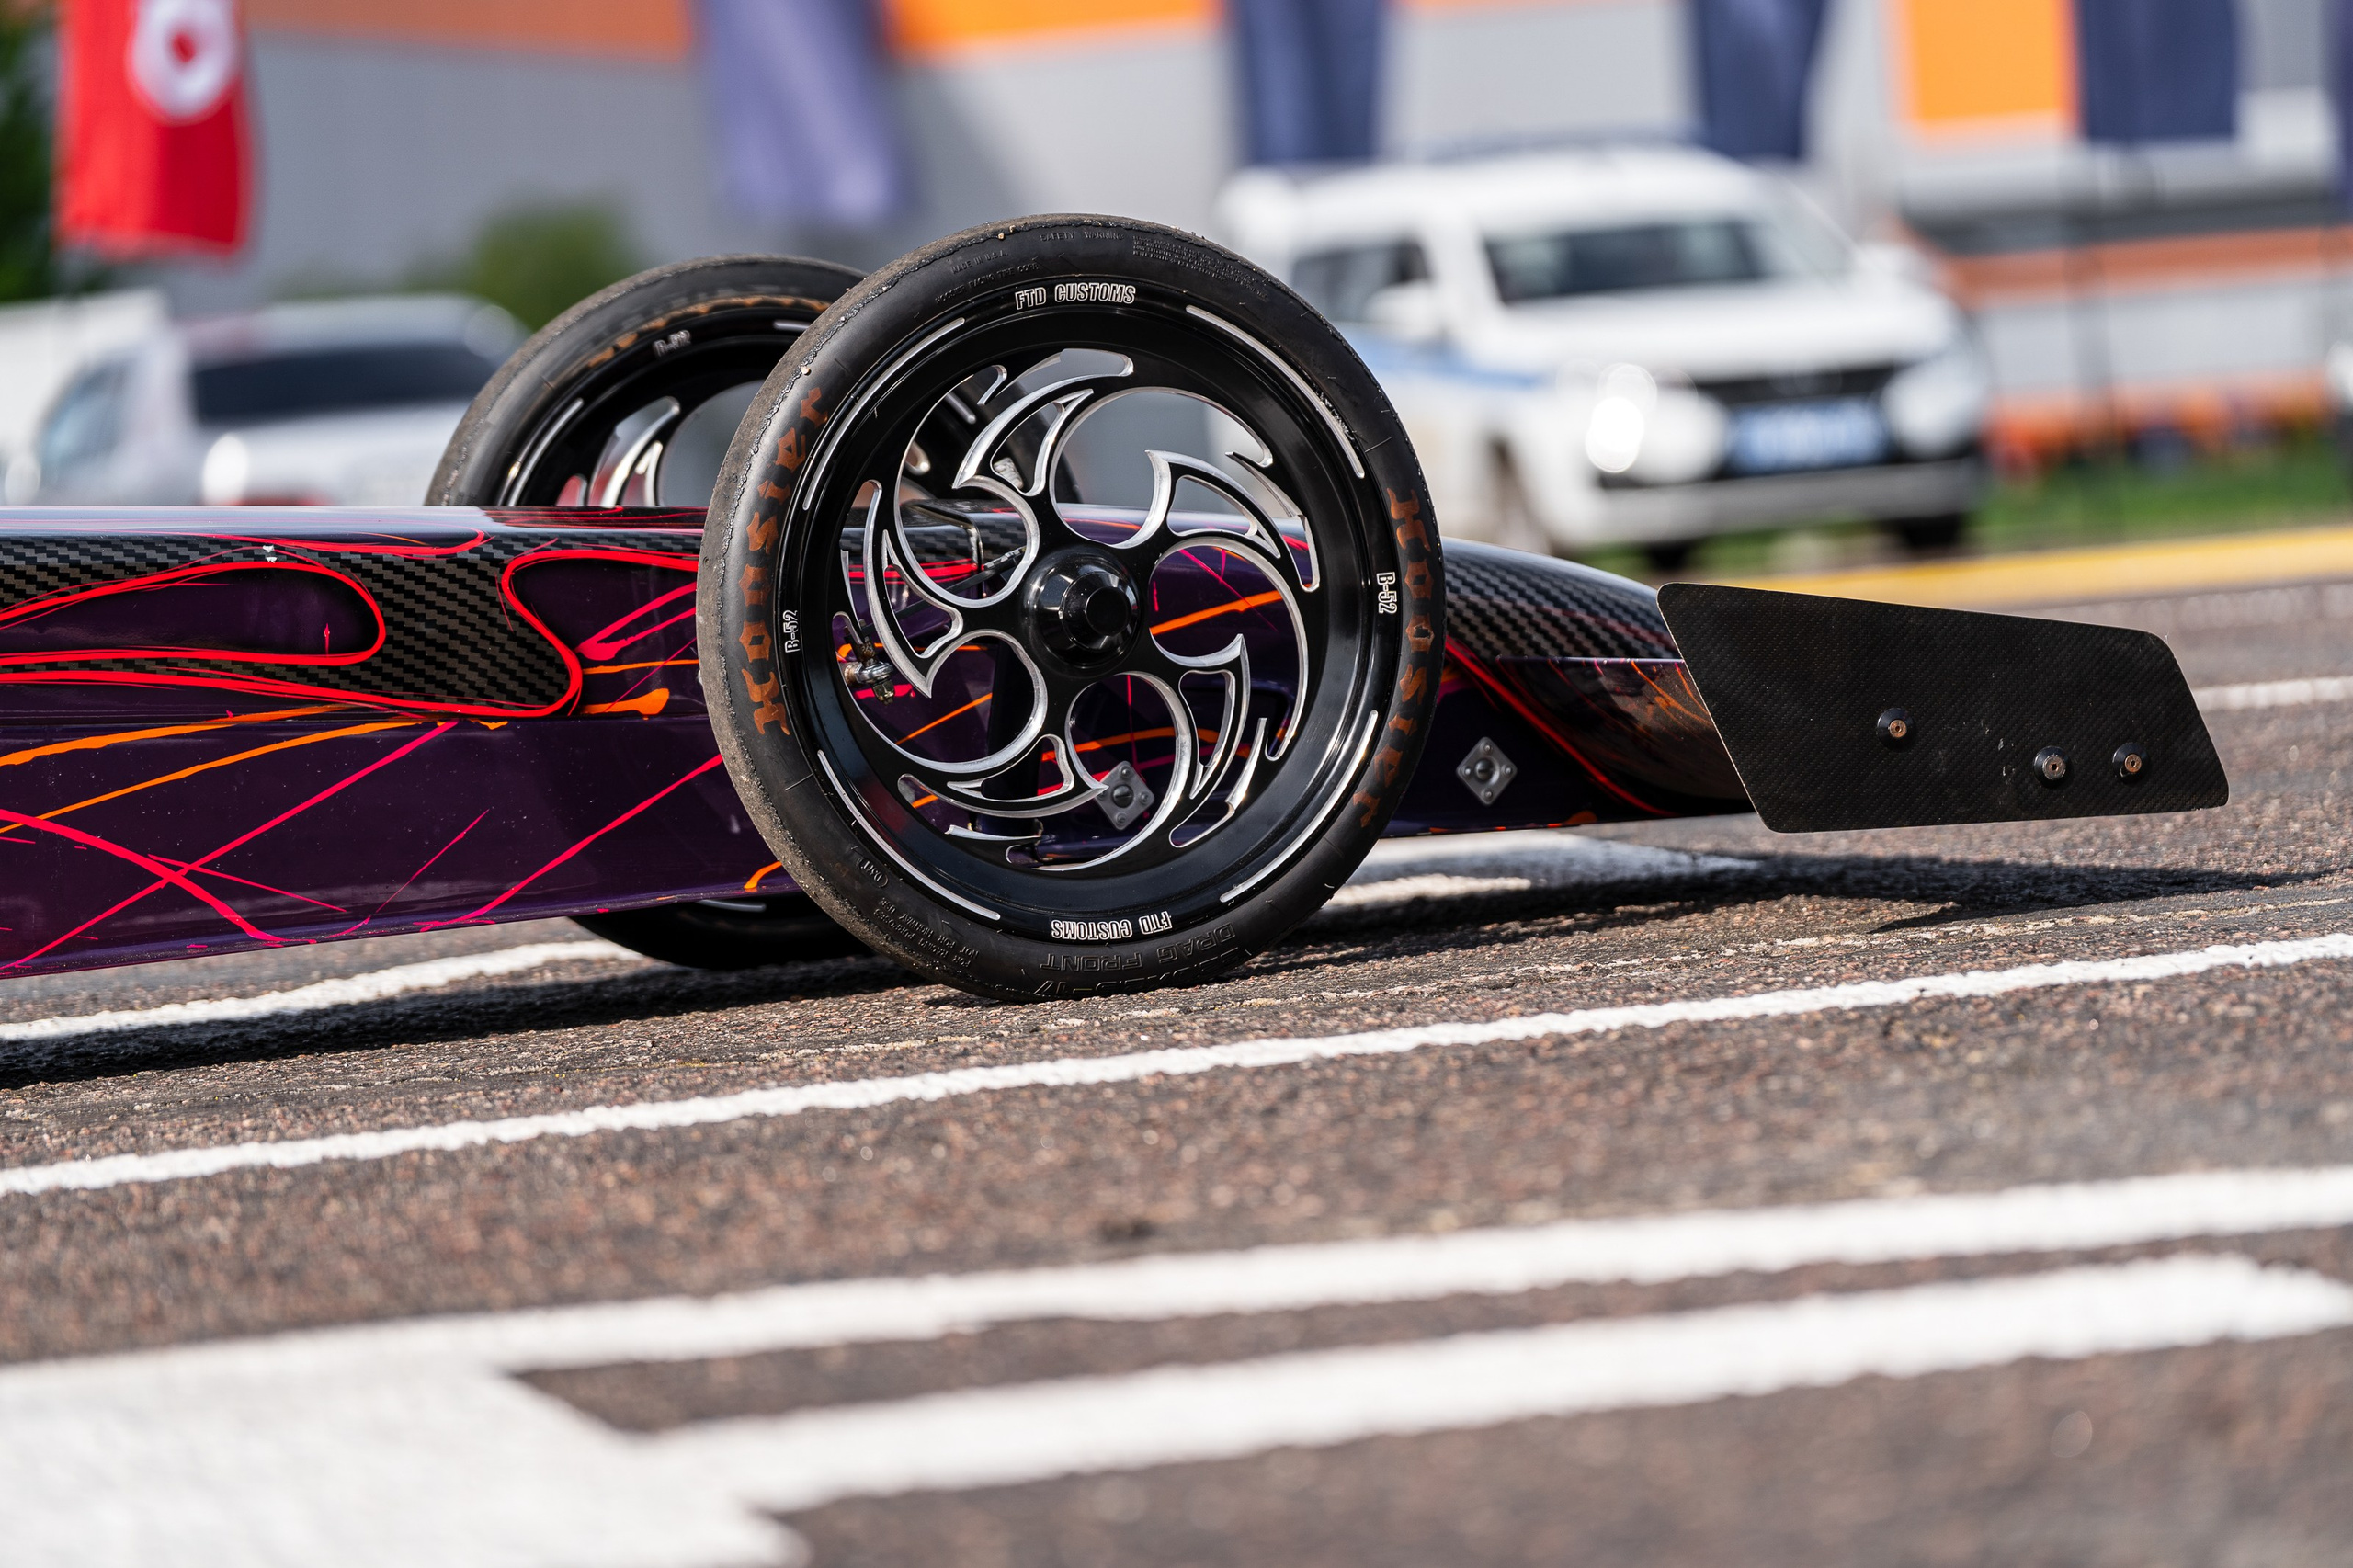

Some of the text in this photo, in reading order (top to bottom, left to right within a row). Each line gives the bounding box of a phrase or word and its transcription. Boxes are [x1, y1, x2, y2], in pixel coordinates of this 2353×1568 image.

[1040, 232, 1075, 242] SAFETY
[951, 260, 972, 275] MADE
[974, 256, 983, 266] IN
[1015, 282, 1136, 310] FTD CUSTOMS
[1376, 571, 1398, 614] B-52
[784, 609, 799, 653] B-52
[898, 913, 935, 937] HIGHWAY
[1051, 910, 1173, 941] FTD CUSTOMS
[937, 935, 956, 949] FOR
[1040, 922, 1236, 972] DRAG FRONT
